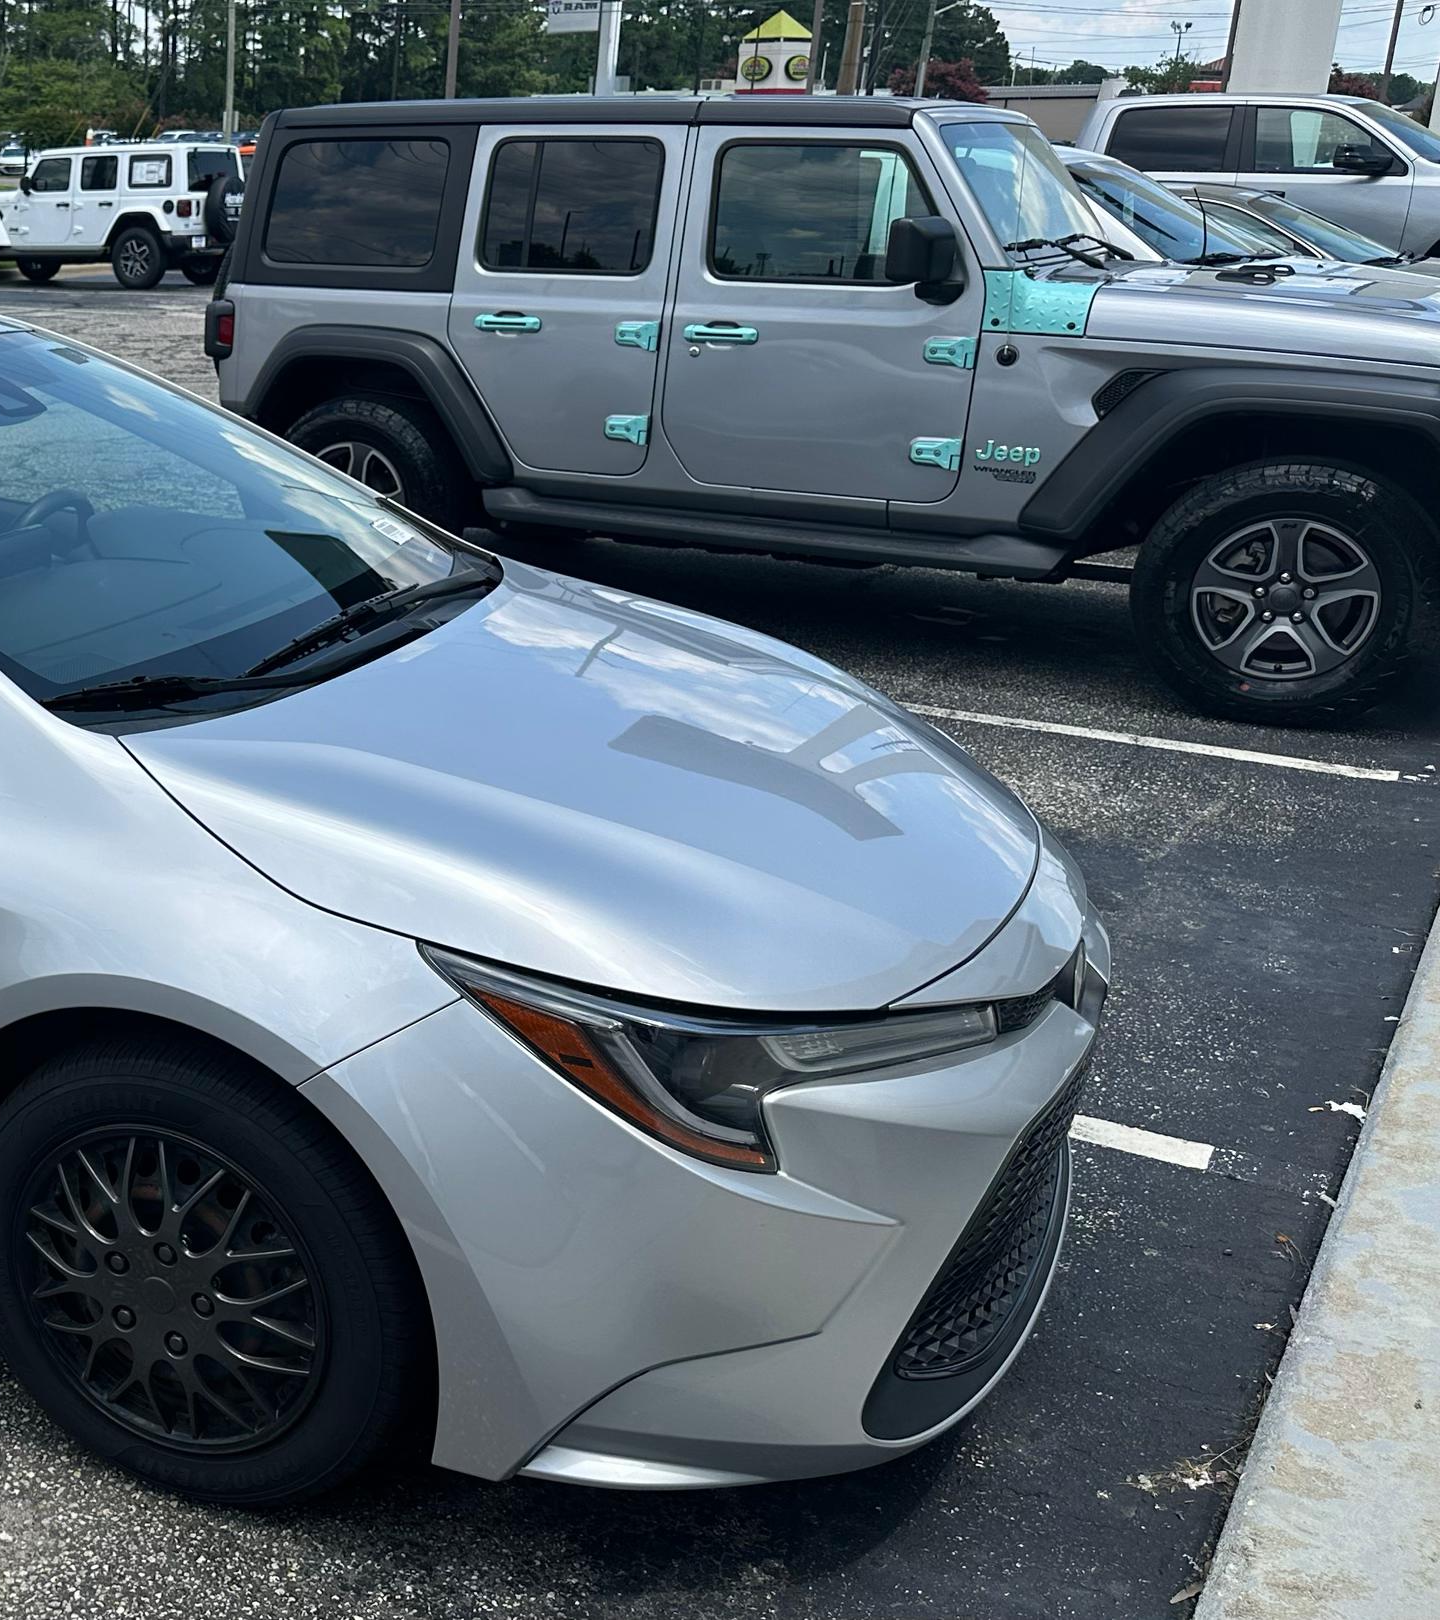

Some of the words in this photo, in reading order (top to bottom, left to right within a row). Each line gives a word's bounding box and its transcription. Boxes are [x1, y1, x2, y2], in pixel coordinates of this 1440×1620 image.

[564, 3, 598, 11] RAM
[976, 440, 1040, 466] Jeep
[973, 465, 1036, 477] WRANGLER
